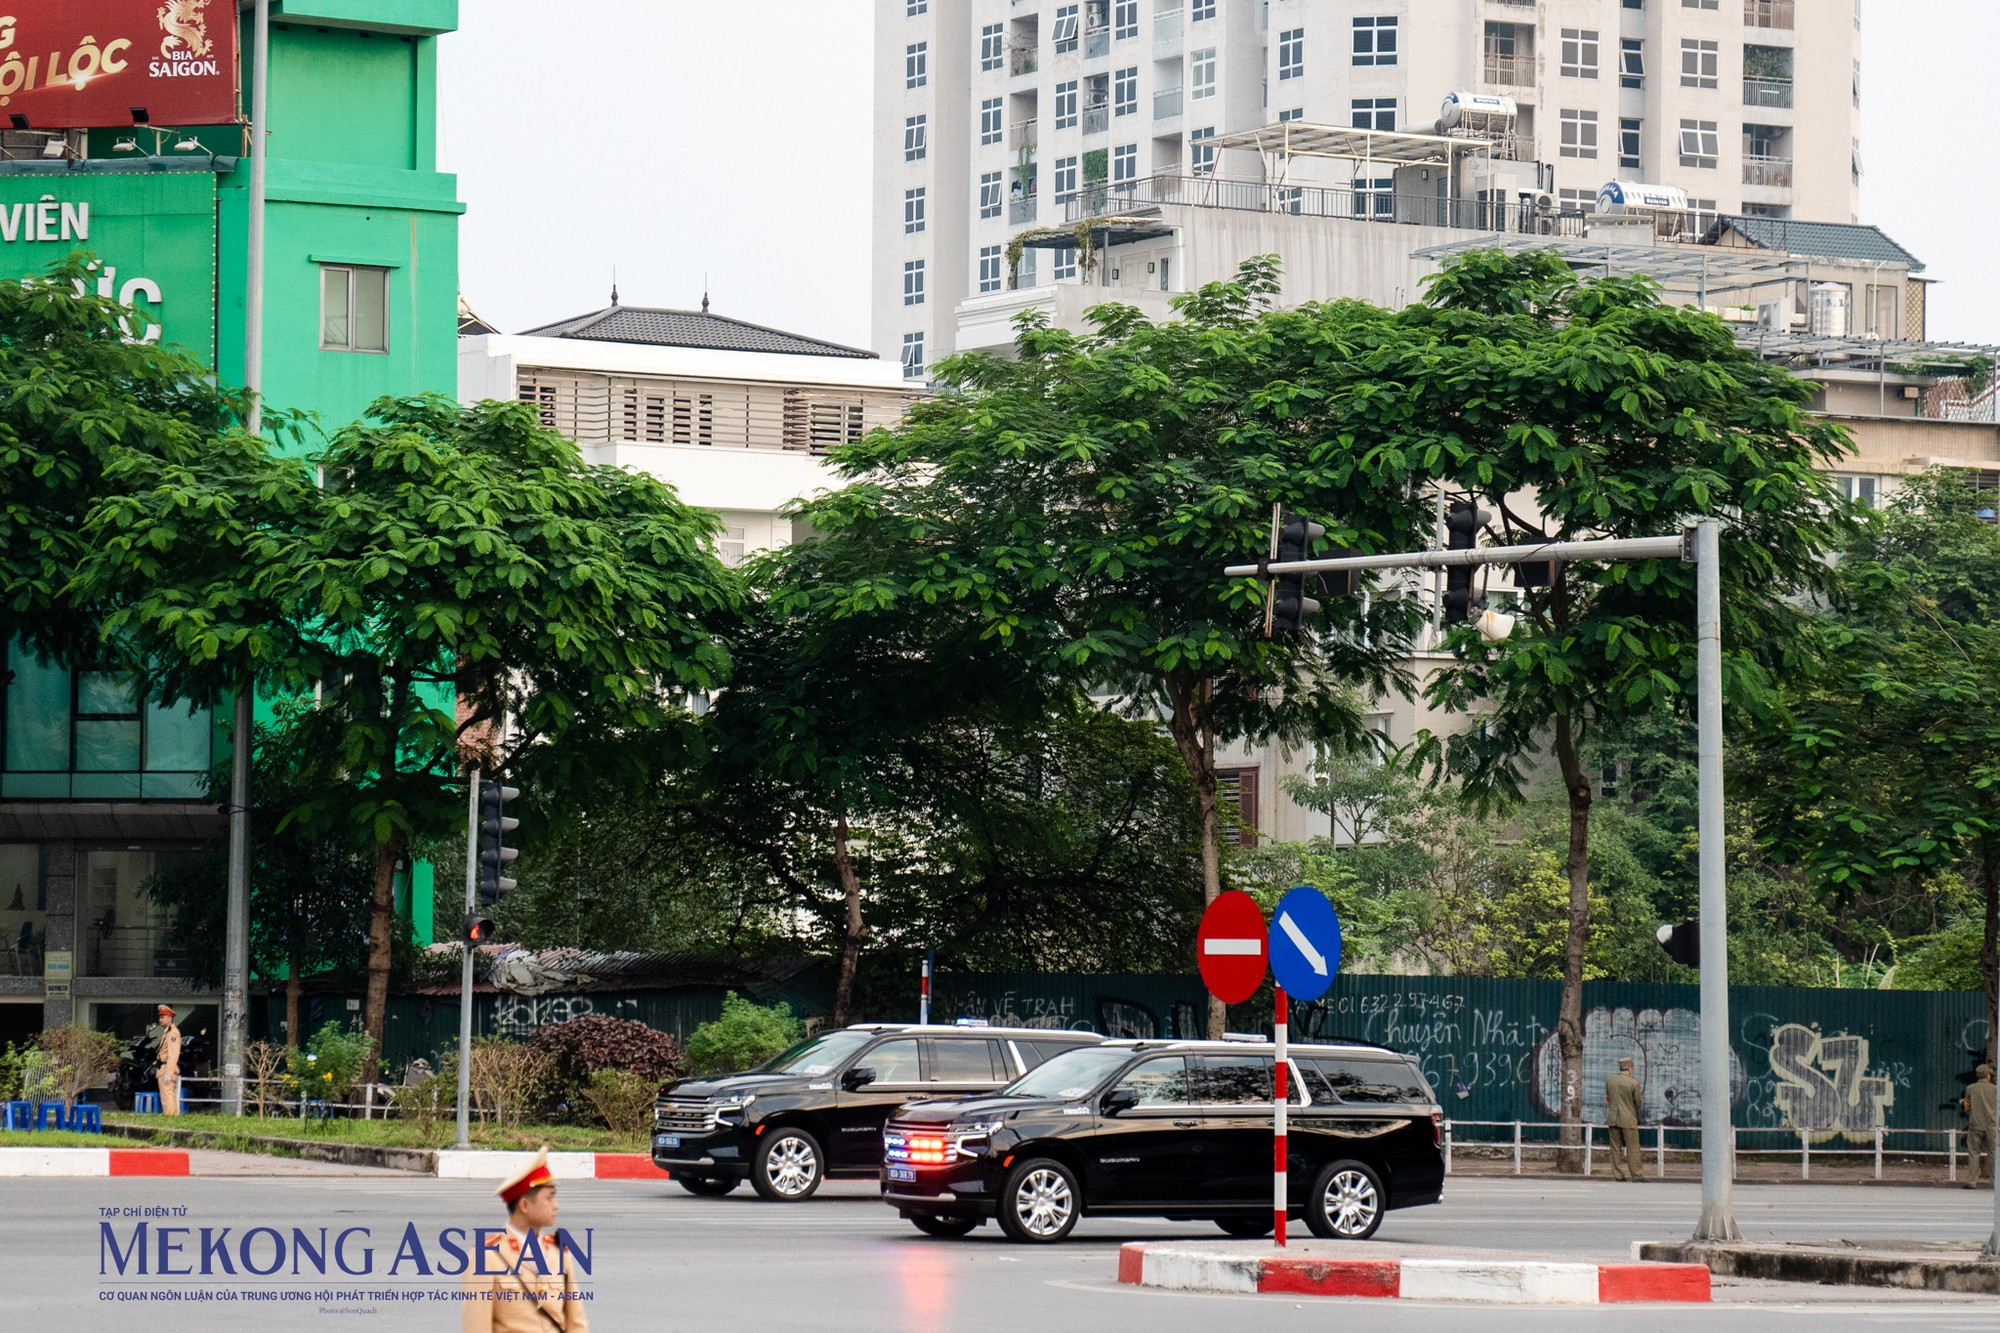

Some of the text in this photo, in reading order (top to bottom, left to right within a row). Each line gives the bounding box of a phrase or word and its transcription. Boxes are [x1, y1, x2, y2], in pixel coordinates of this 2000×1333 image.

[45, 34, 132, 92] LỘC
[149, 61, 217, 78] SAIGON
[172, 50, 194, 61] BIA
[0, 194, 89, 242] VIÊN
